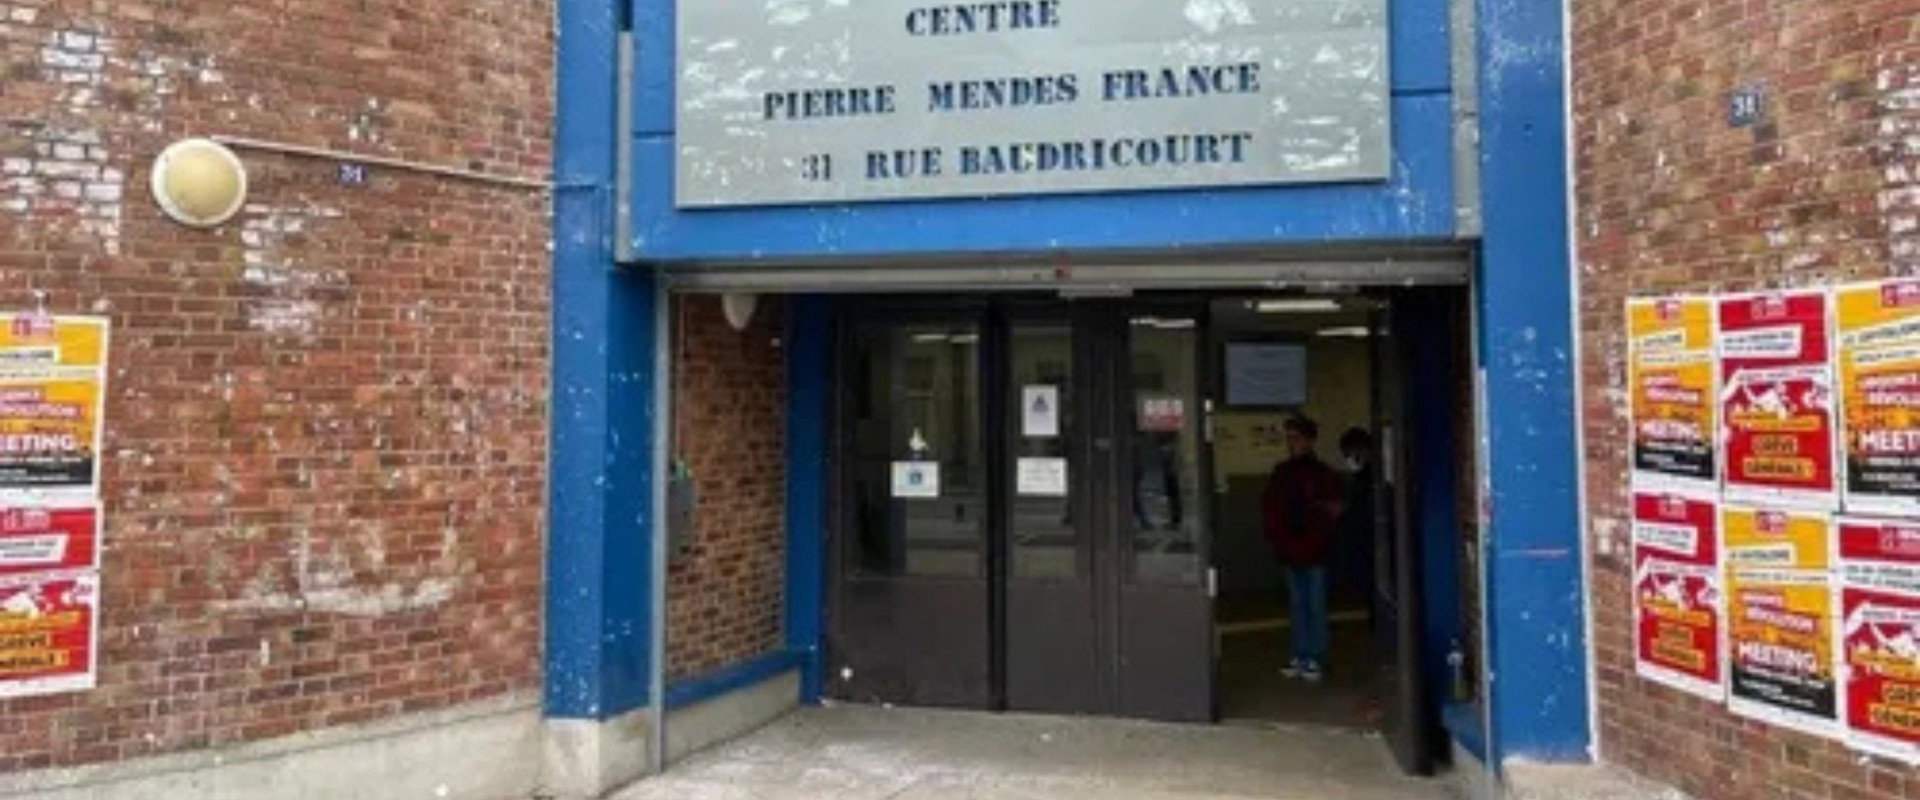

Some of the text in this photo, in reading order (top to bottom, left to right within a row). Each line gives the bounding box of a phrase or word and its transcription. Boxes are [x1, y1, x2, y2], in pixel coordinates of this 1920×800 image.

[905, 0, 1060, 35] CENTRE
[763, 62, 1260, 119] PIERRE MENDES FRANCE
[803, 132, 1253, 180] 31 RUE BAUDRICOURT
